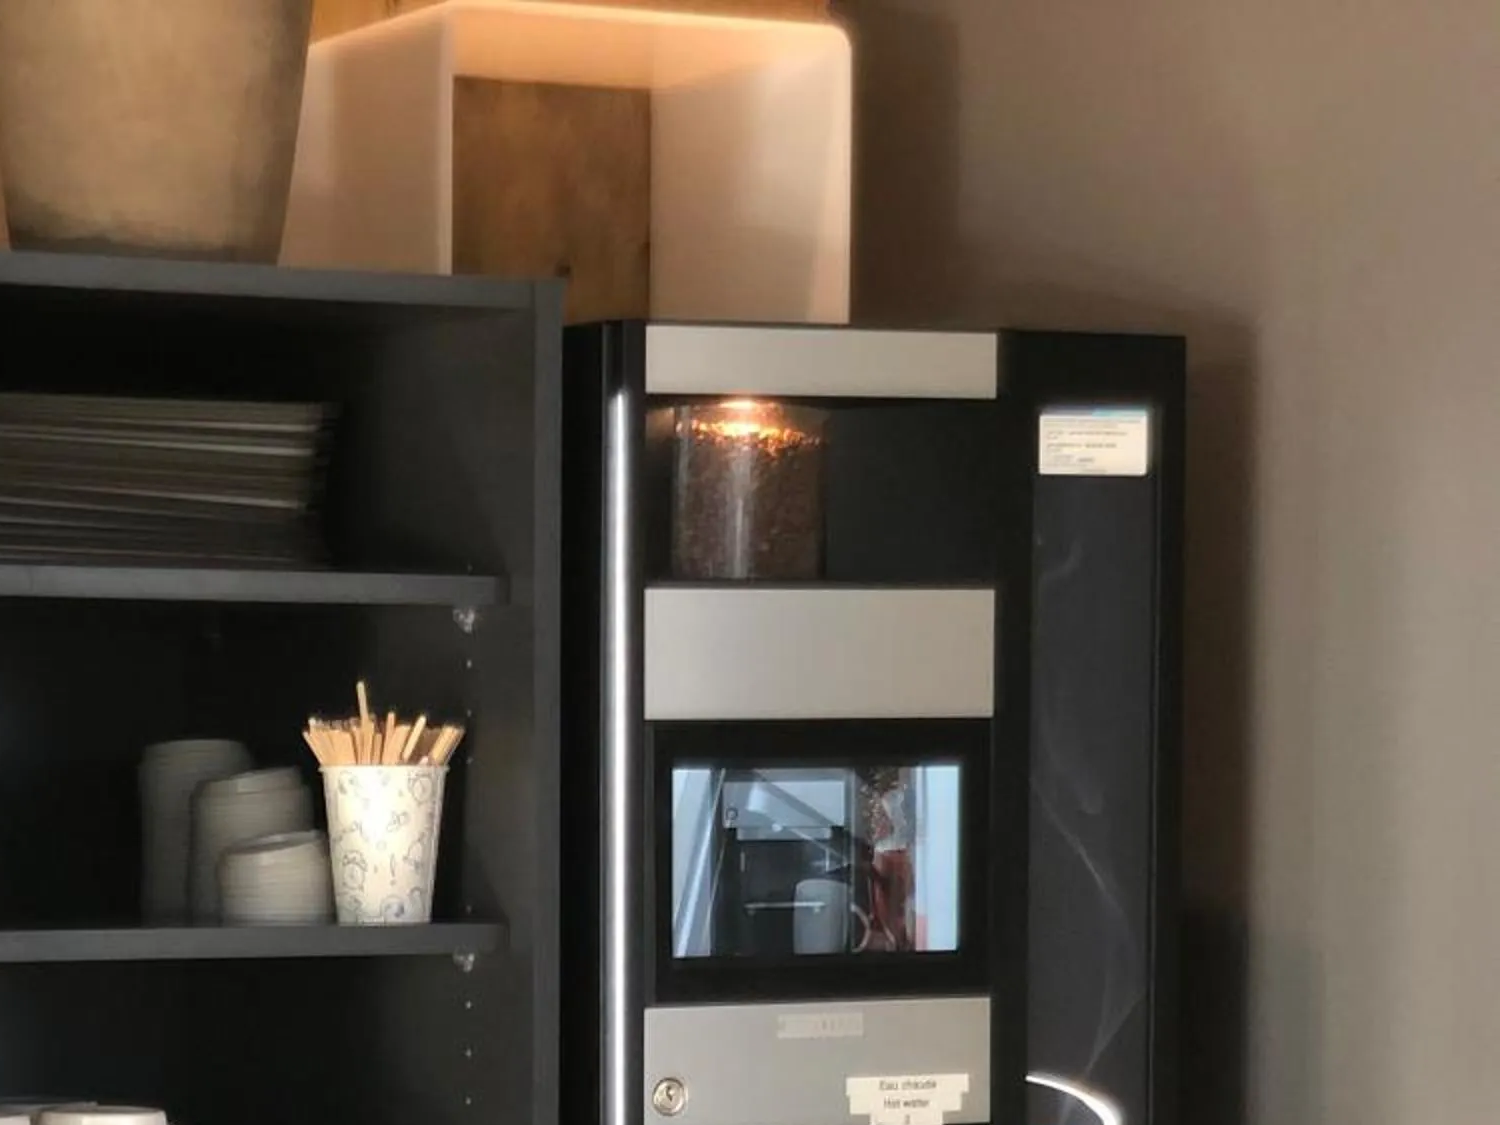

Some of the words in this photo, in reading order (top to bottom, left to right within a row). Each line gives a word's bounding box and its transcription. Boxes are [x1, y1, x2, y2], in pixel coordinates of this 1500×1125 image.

[879, 1079, 899, 1091] Eau
[901, 1078, 937, 1091] chaude
[883, 1097, 901, 1109] Hot
[903, 1097, 930, 1109] water
